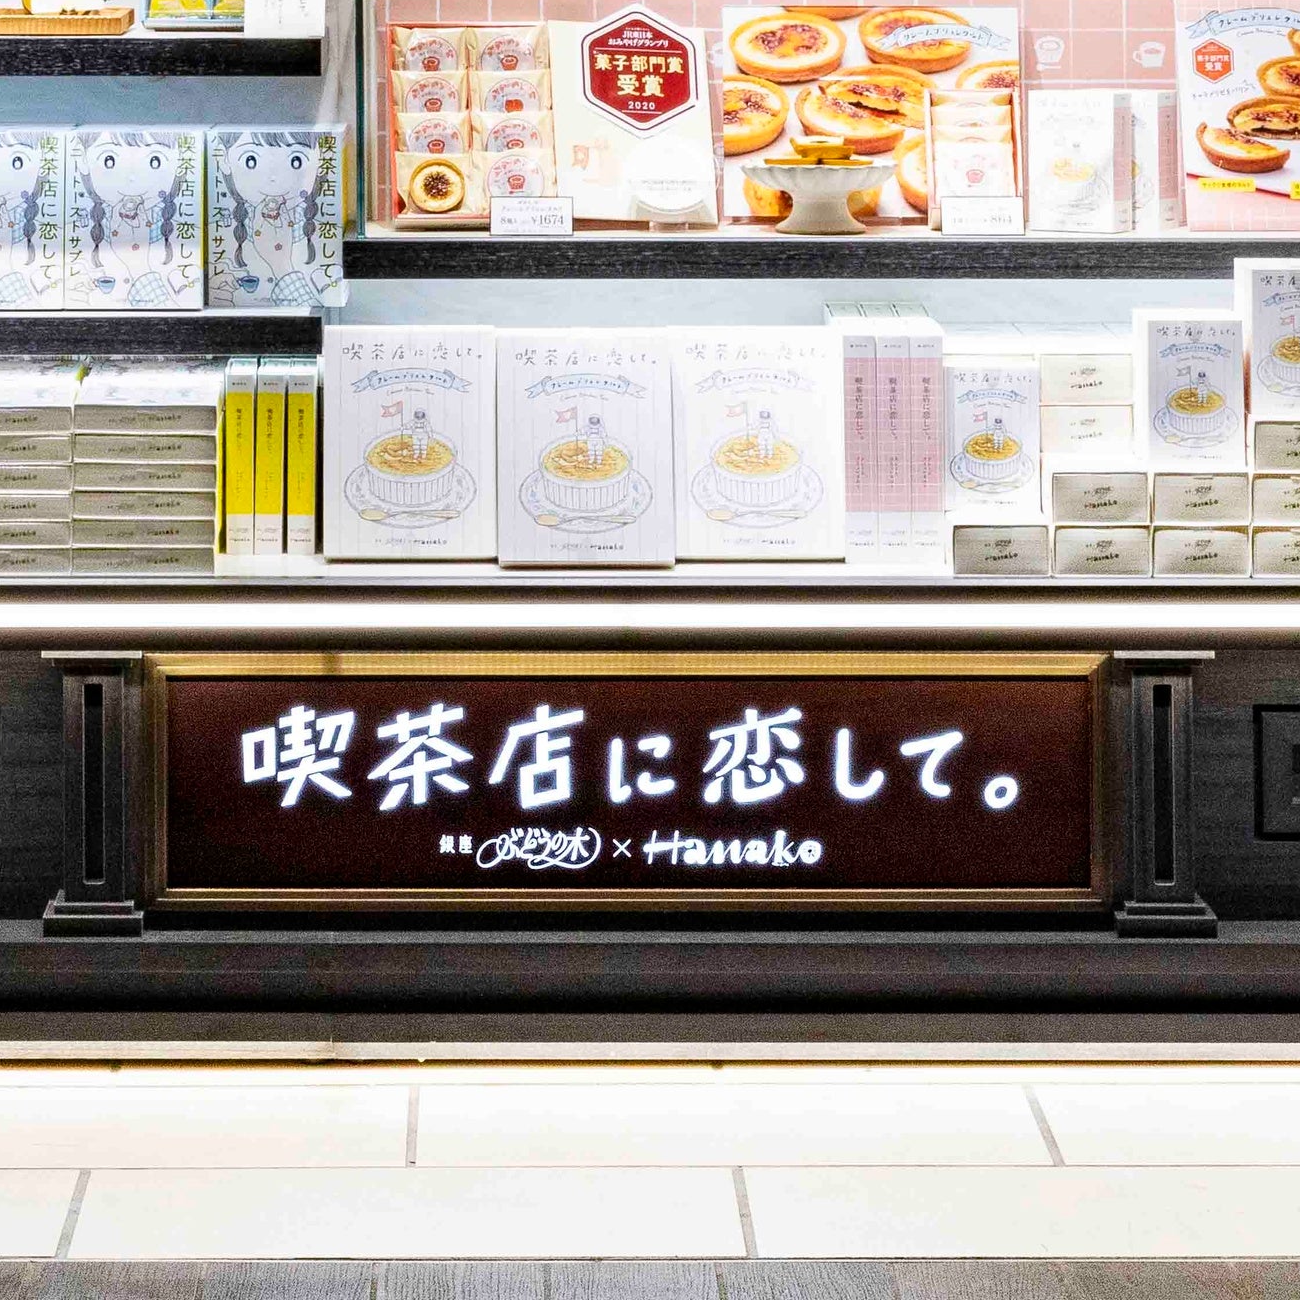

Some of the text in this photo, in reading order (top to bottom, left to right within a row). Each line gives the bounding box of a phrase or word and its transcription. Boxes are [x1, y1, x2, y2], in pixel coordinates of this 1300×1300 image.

[593, 53, 685, 75] 菓子部門賞
[616, 73, 665, 98] 受賞
[627, 101, 656, 110] 2020
[341, 341, 483, 361] 喫茶店に恋して。
[515, 349, 657, 368] 喫茶店に恋して。
[240, 702, 1022, 813] 喫茶店に恋して。
[438, 833, 475, 856] 銀座
[477, 826, 604, 871] ぶどうの木
[643, 827, 823, 868] Hanako
